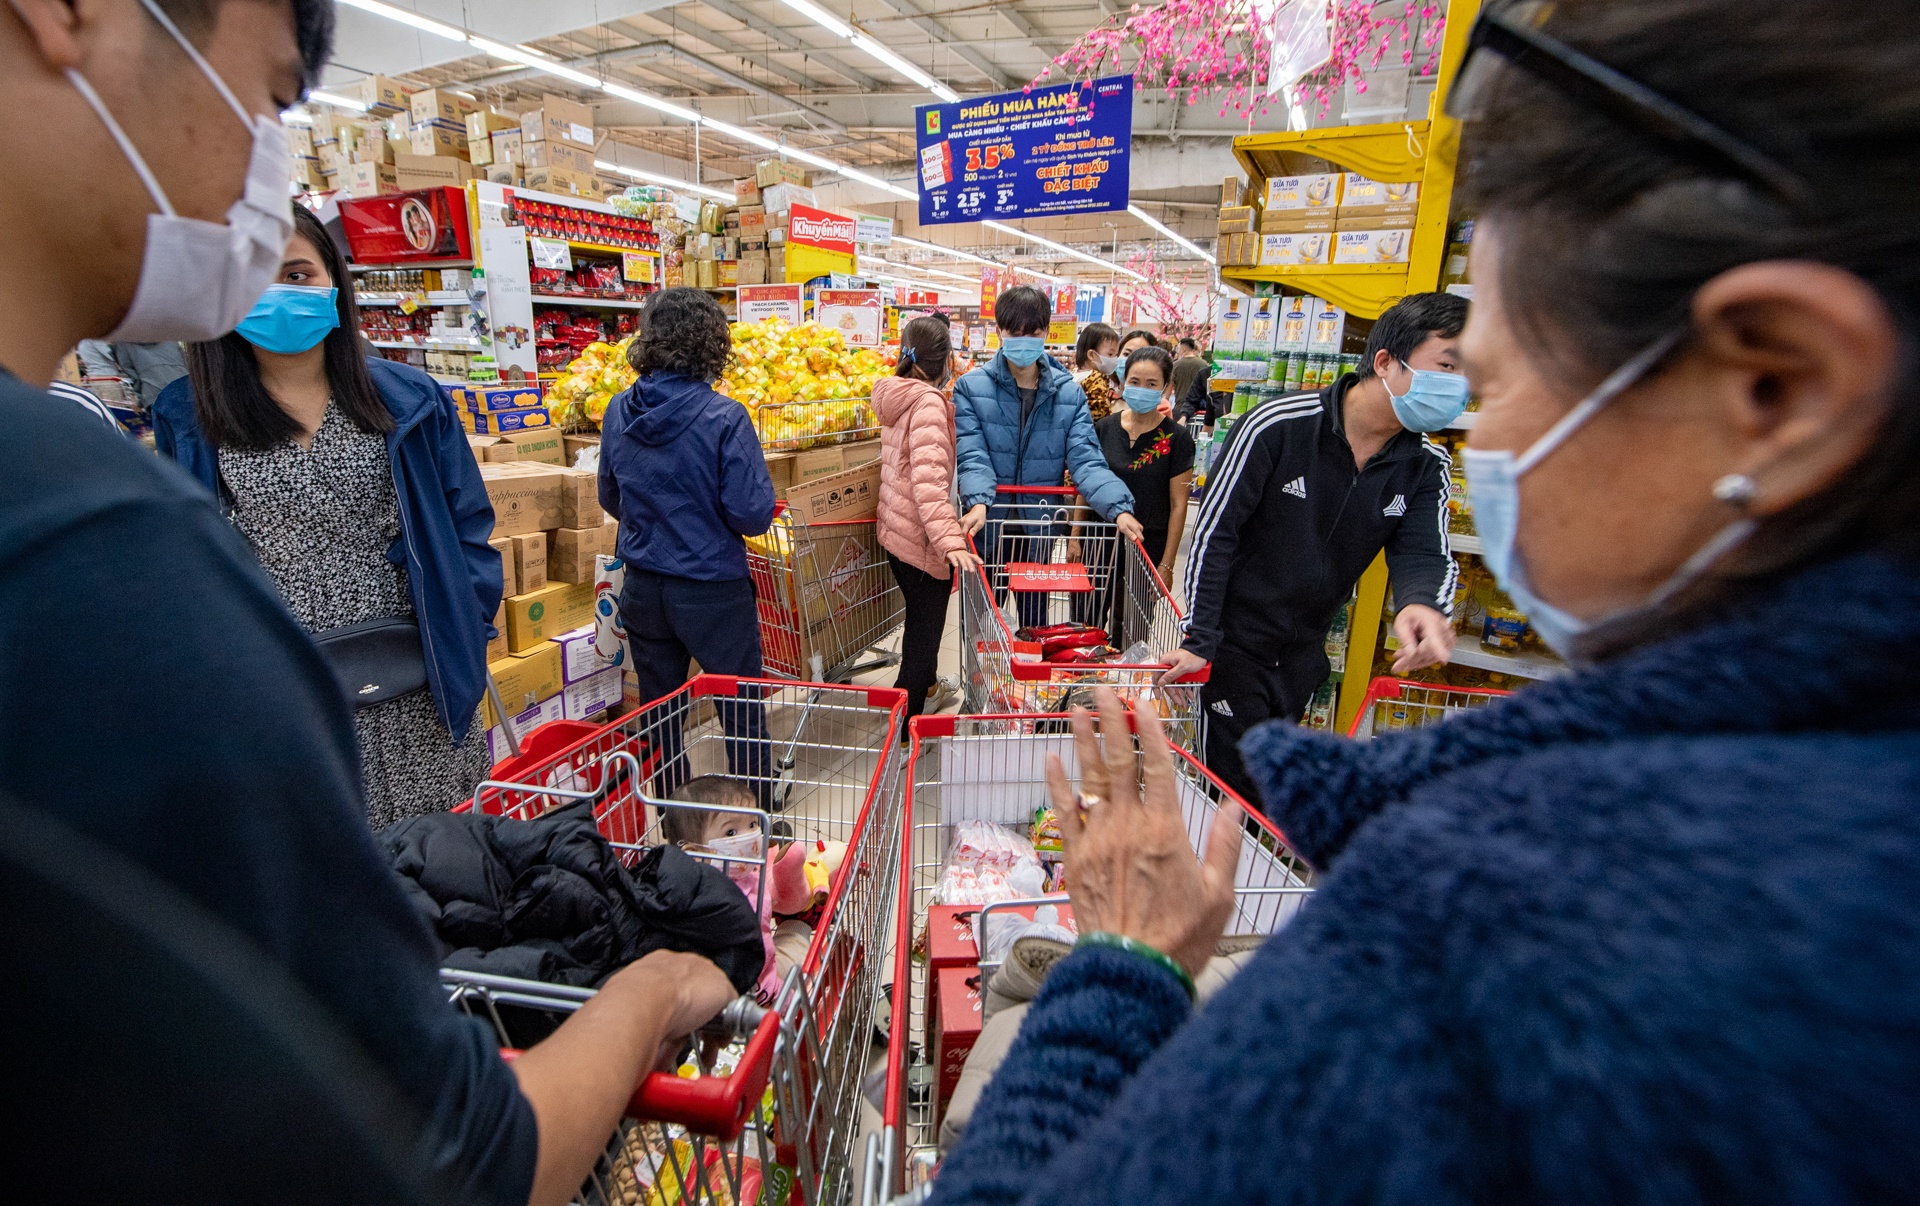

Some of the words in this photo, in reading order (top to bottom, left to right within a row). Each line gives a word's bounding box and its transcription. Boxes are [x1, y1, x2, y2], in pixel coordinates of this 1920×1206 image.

[1098, 84, 1123, 93] CENTRAL
[960, 101, 999, 120] PHIẾU
[1003, 99, 1034, 114] MUA
[1038, 92, 1078, 109] HÀNG
[948, 131, 963, 139] MUA
[964, 128, 983, 137] CÀNG
[984, 124, 1005, 135] NHIỀU
[1010, 120, 1031, 131] CHIẾT
[1032, 116, 1052, 128] KHẤU
[1055, 133, 1066, 141] Khi
[1083, 130, 1091, 138] từ
[1032, 146, 1038, 155] 2
[1039, 143, 1050, 154] TỶ
[1051, 141, 1076, 153] ĐỒNG
[1077, 137, 1096, 149] TRỞ
[1097, 136, 1115, 148] LÊN
[924, 156, 937, 165] 300
[965, 143, 1015, 172] 3.5%
[1036, 162, 1072, 179] CHIẾT
[1073, 158, 1109, 176] KHẤU
[925, 174, 937, 182] 500
[964, 173, 978, 182] 500
[998, 170, 1004, 179] 2
[1350, 175, 1362, 183] SỮA
[1044, 178, 1070, 195] ĐẶC
[1072, 175, 1101, 192] BIỆT
[1273, 179, 1285, 188] SỮA
[933, 196, 947, 210] 1%
[957, 192, 986, 208] 2.5%
[997, 189, 1014, 205] 3%
[1267, 236, 1278, 245] SỮA
[1342, 233, 1353, 242] SỮA
[852, 334, 862, 343] 41
[1050, 332, 1058, 340] 19
[1282, 487, 1307, 499] adidas
